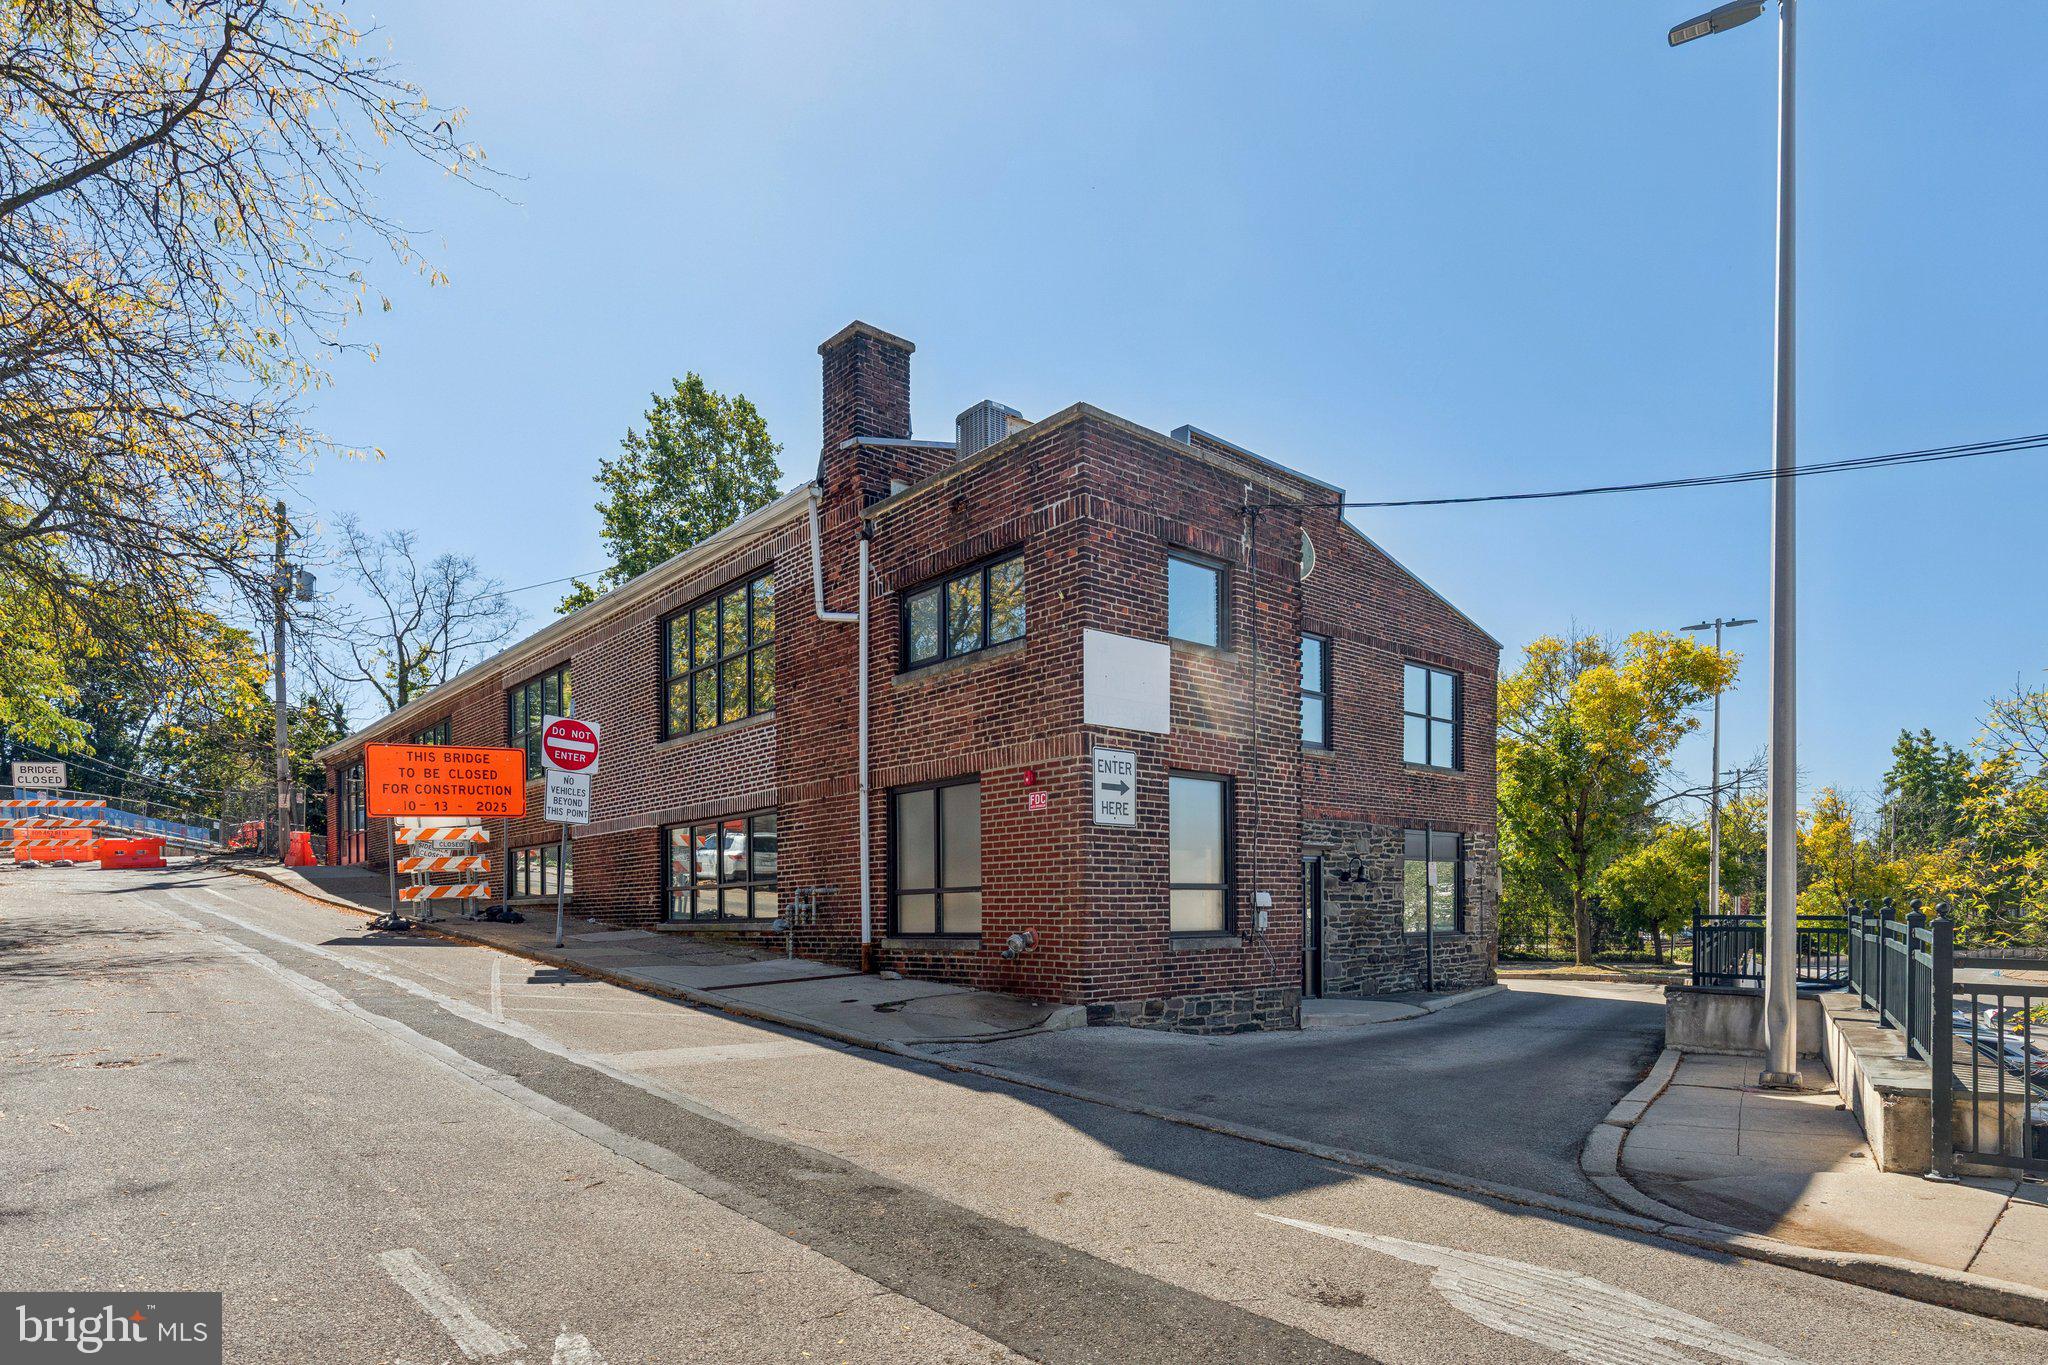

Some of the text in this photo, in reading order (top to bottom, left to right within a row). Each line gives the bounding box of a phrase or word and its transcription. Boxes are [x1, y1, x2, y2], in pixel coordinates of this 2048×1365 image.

[551, 726, 591, 740] DO NOT
[406, 751, 490, 764] THIS BRIDGE
[554, 750, 586, 763] ENTER
[19, 765, 58, 774] BRIDGE
[398, 767, 498, 780] TO BE CLOSED
[1097, 759, 1132, 776] ENTER
[17, 776, 63, 784] CLOSED
[563, 777, 575, 786] NO
[382, 783, 512, 796] FOR CONSTRUCTION
[550, 785, 586, 797] VEHICLES
[553, 796, 583, 808] BEYOND
[1030, 793, 1046, 805] FDC
[434, 801, 448, 811] 13
[476, 801, 508, 812] 2025
[547, 806, 588, 818] THIS POINT
[1101, 801, 1129, 816] HERE
[418, 841, 449, 854] SIDELK
